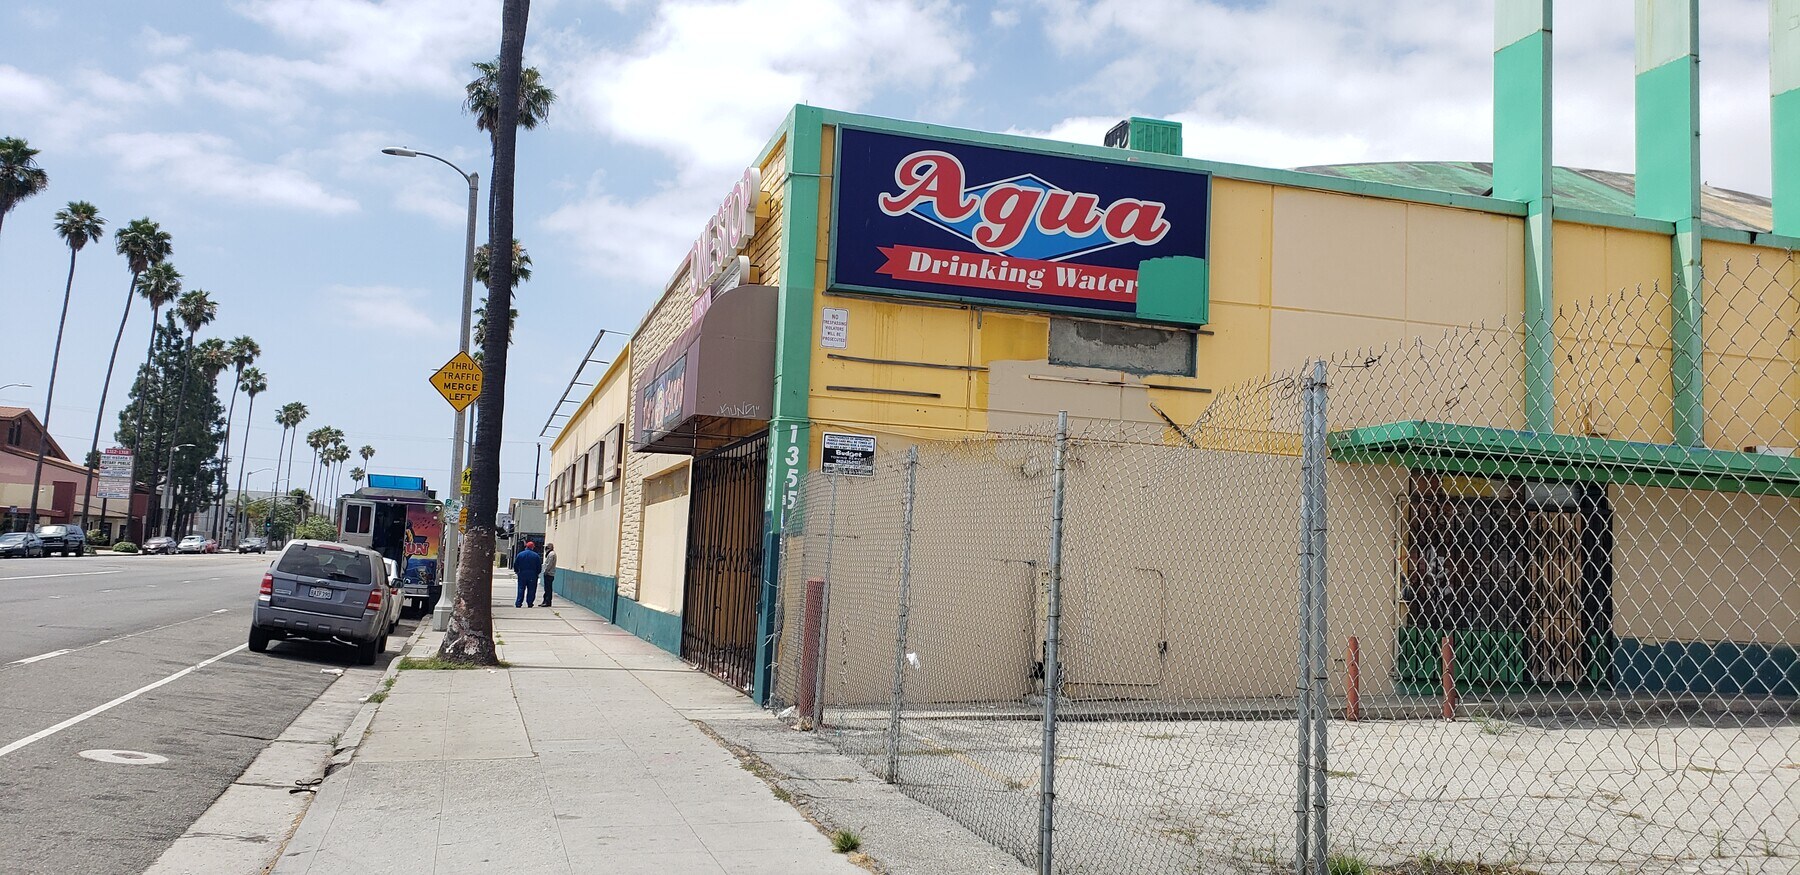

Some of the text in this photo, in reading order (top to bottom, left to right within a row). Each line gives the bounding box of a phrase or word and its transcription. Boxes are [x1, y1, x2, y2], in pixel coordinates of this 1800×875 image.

[879, 150, 1171, 253] Agua
[908, 251, 1139, 295] Drinking Water
[451, 362, 474, 370] THRU
[443, 372, 480, 381] TRAFFIC
[444, 383, 478, 391] MERGE
[449, 393, 472, 401] LEFT
[835, 449, 863, 458] Budget
[785, 424, 800, 510] 1355
